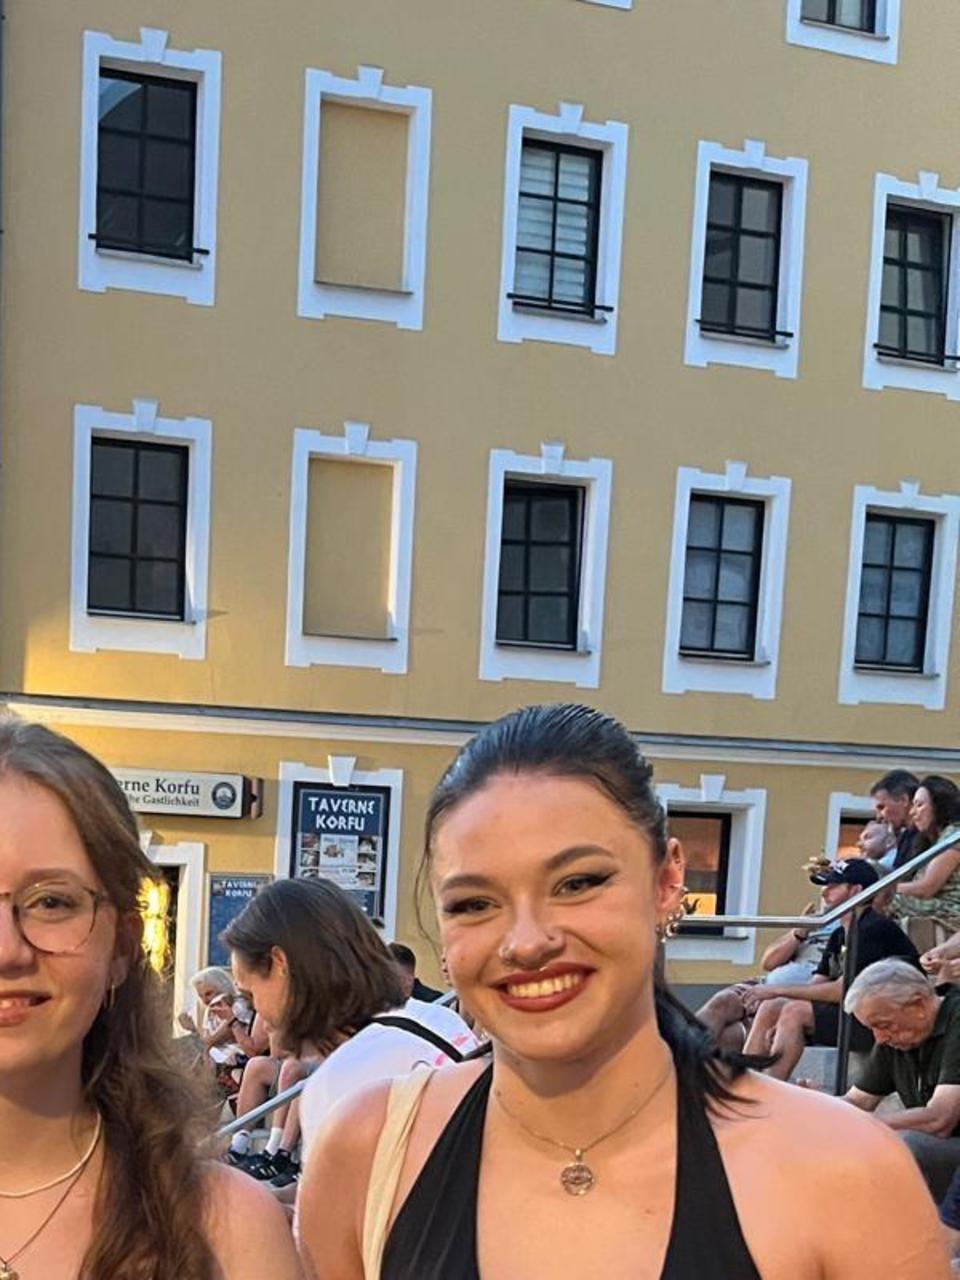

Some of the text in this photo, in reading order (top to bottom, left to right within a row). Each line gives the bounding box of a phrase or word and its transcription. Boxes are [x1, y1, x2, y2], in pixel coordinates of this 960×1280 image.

[118, 778, 200, 795] erne Korfu
[308, 796, 376, 815] TAVERNE
[315, 814, 366, 831] KORFU
